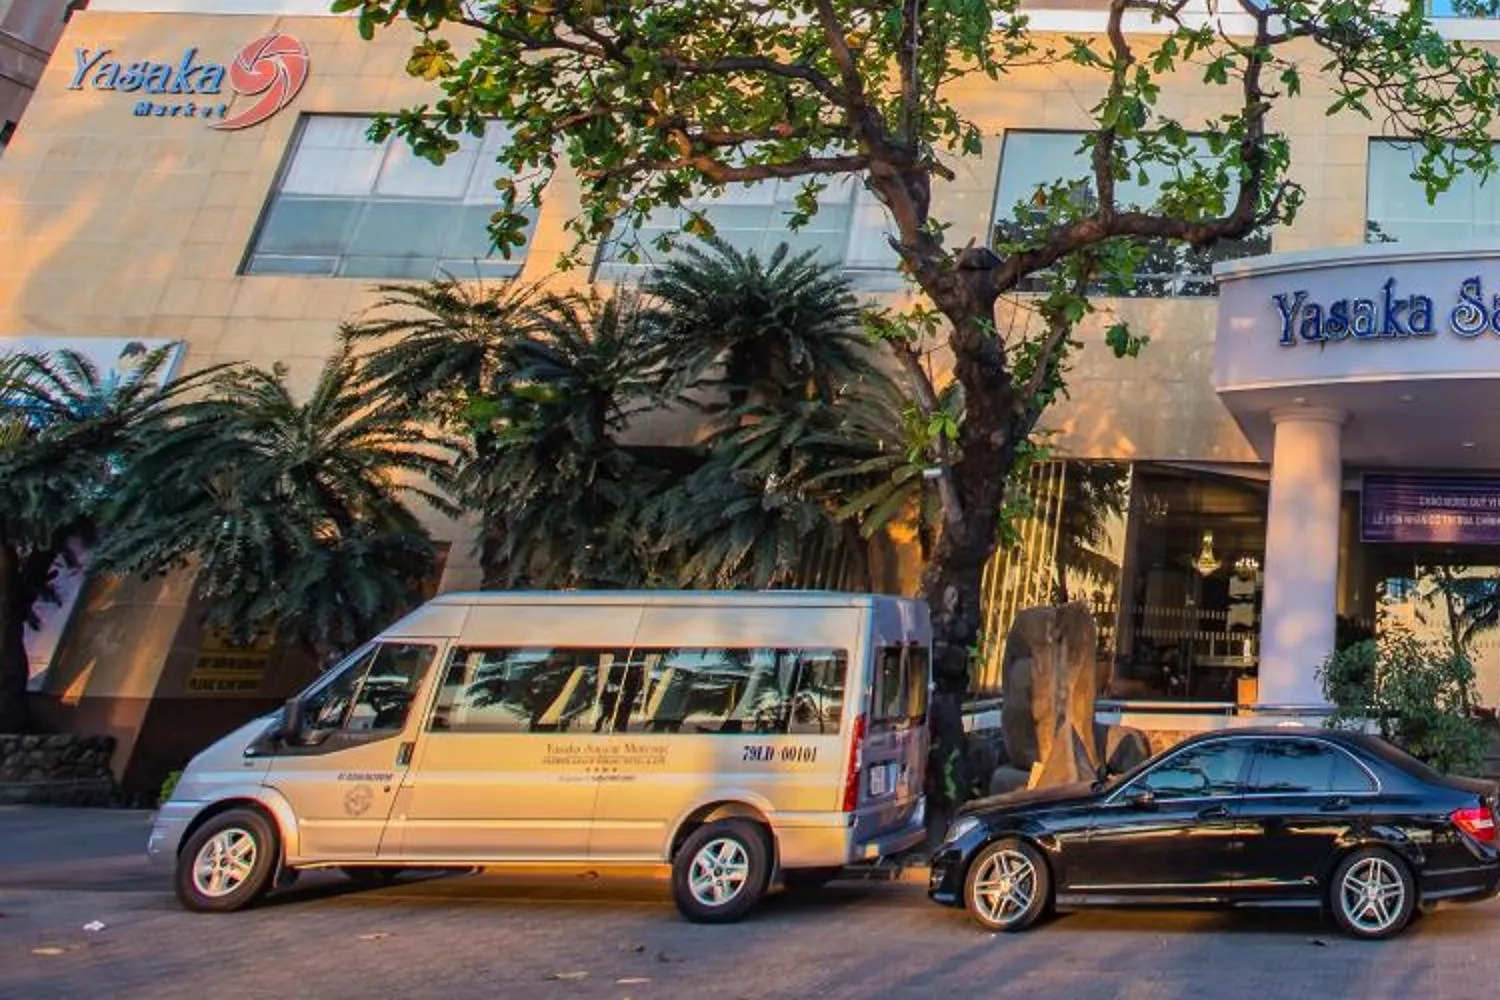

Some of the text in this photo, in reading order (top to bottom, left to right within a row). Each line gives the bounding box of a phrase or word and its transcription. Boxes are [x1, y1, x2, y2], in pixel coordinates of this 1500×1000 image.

[66, 47, 226, 94] Yasaka
[133, 102, 227, 117] Market
[1272, 277, 1435, 347] Yasaka
